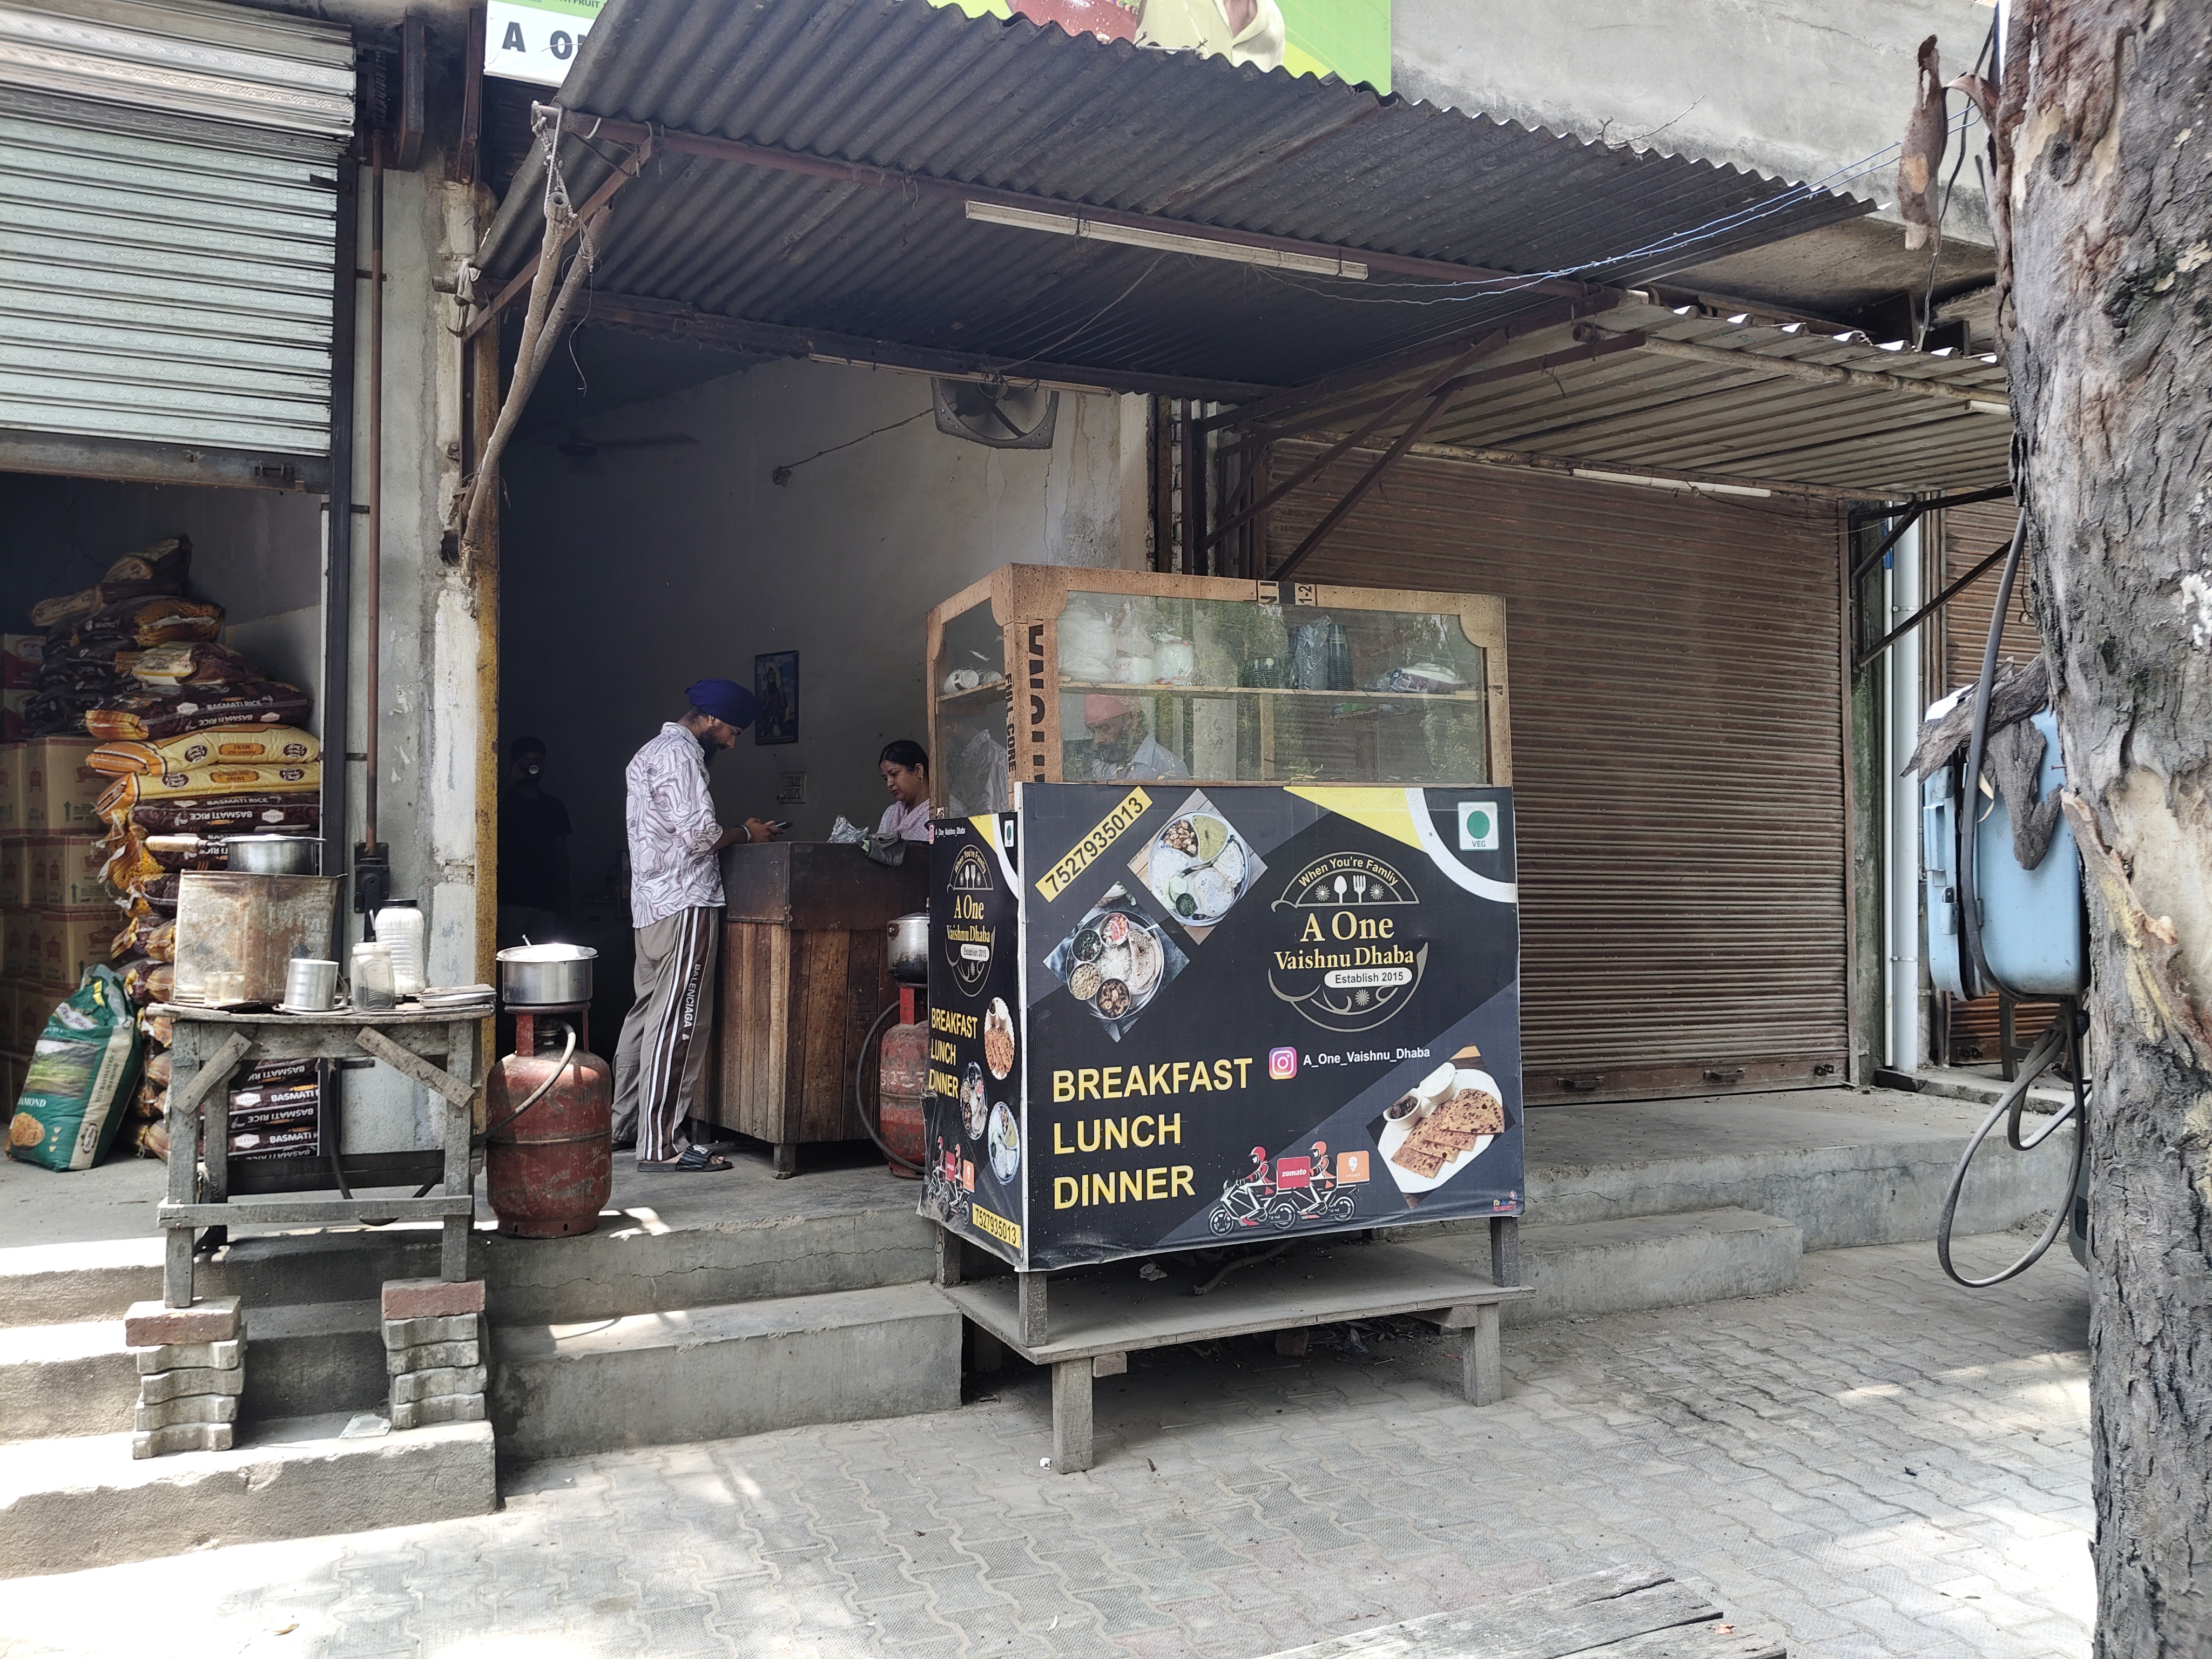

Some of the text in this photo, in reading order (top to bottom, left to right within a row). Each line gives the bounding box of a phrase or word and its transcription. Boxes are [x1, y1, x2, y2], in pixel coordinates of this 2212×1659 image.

[502, 21, 527, 53] A
[207, 702, 243, 711] BASMATI
[244, 700, 262, 708] RICE
[216, 714, 253, 723] BASMATI
[198, 717, 216, 726] RICE
[1007, 723, 1016, 773] CORE
[190, 812, 210, 820] RICE
[1044, 797, 1143, 893] 7527935013
[954, 856, 964, 874] When
[963, 849, 975, 859] You're
[1298, 864, 1328, 887] When
[1329, 857, 1364, 869] You're
[954, 894, 984, 920] A One
[946, 924, 990, 943] Vaishnu Dhaba
[1299, 911, 1395, 942] A One
[963, 947, 987, 957] Establish 2015
[1273, 944, 1414, 970] Vaishnu Dhaba
[1335, 972, 1404, 984] Establish 2015
[683, 963, 702, 1028] BALENCIAGA
[931, 1007, 978, 1040] BREAKFAST
[930, 1038, 956, 1066] LUNCH
[1303, 1047, 1431, 1068] A_One_Vaishnu_Dhaba
[263, 1065, 305, 1078] BASMATI
[928, 1068, 959, 1100] DINNER
[1053, 1057, 1253, 1103] BREAKFAST
[271, 1091, 314, 1102] BASMATI
[247, 1108, 314, 1123] BASMATI RICE
[270, 1132, 312, 1143] BASMATI
[1054, 1112, 1181, 1155] LUNCH
[1282, 1169, 1307, 1177] zomato
[1054, 1165, 1196, 1210] DINNER
[975, 1208, 1016, 1245] 7527935013
